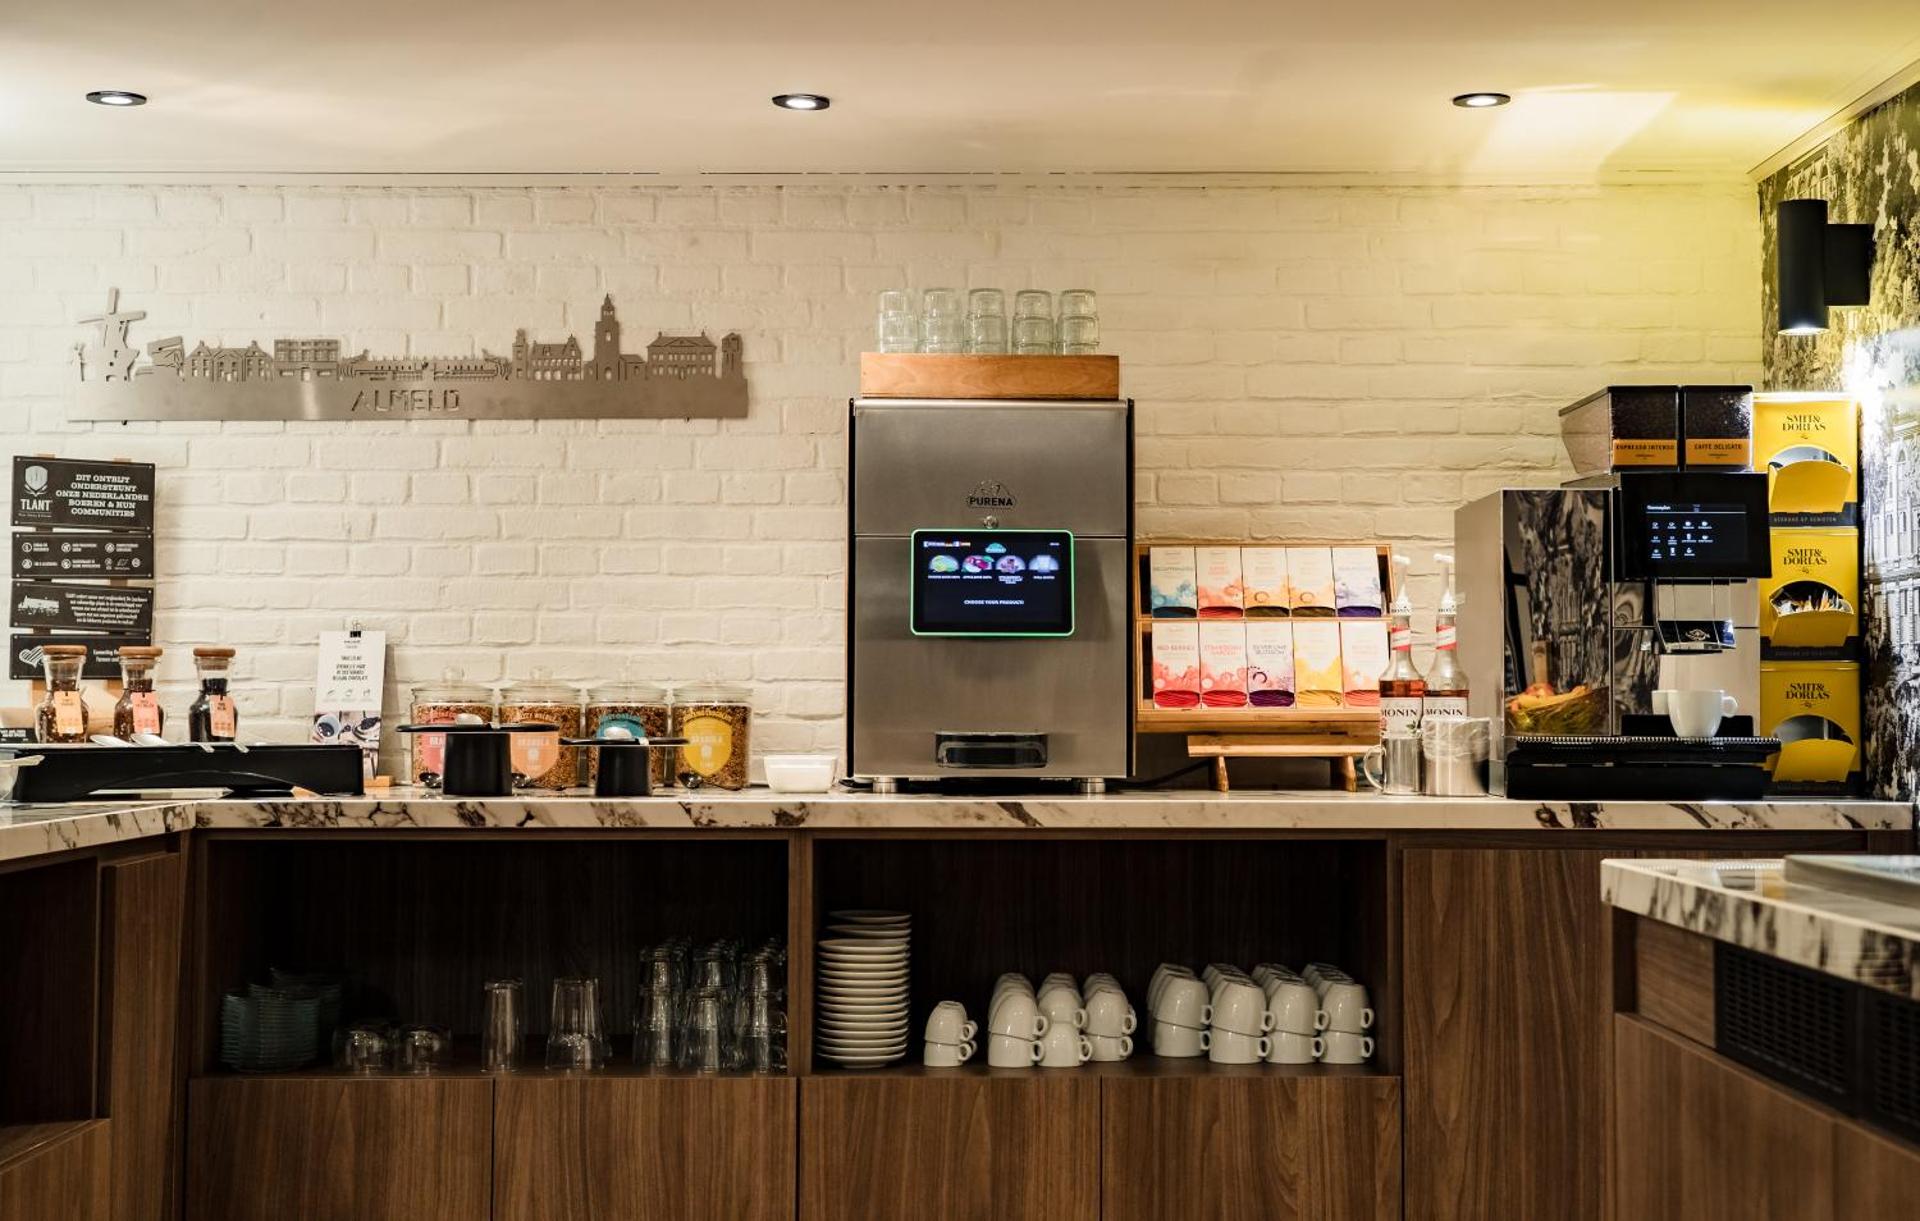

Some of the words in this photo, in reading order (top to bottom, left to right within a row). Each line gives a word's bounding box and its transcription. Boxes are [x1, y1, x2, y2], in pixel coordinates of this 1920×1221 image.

[1782, 423, 1827, 431] DORLAS
[1615, 443, 1647, 451] ESPRESSO
[1648, 443, 1675, 451] INTENSO
[76, 474, 91, 482] DIT
[93, 475, 131, 484] ONTBIJT
[71, 482, 137, 492] ONDERSTEUNT
[55, 490, 81, 498] ONZE
[82, 491, 150, 501] NEDERLANDSE
[20, 499, 51, 511] TLANT
[68, 499, 106, 507] BOEREN
[116, 501, 137, 509] HUN
[969, 497, 1014, 506] PURENA
[71, 509, 136, 518] COMMUNITIES
[1783, 557, 1828, 565] DORLAS
[1785, 691, 1830, 699] DORLAS
[1425, 708, 1464, 716] MONIN
